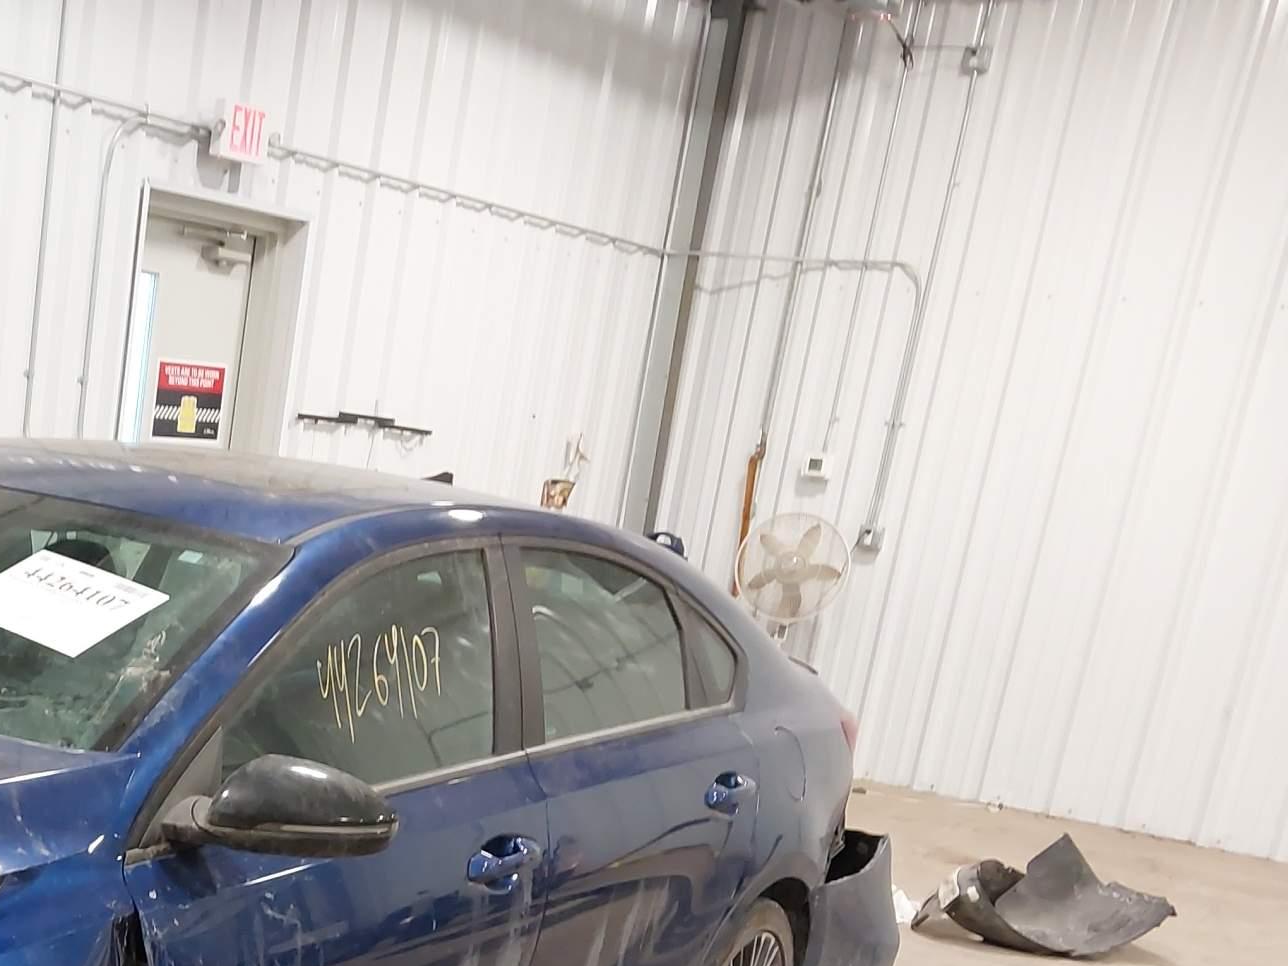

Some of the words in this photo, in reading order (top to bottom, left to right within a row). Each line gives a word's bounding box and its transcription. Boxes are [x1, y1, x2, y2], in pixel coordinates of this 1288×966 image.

[230, 104, 265, 158] EXIT
[24, 567, 130, 610] 44264107
[316, 624, 441, 744] 44264107
